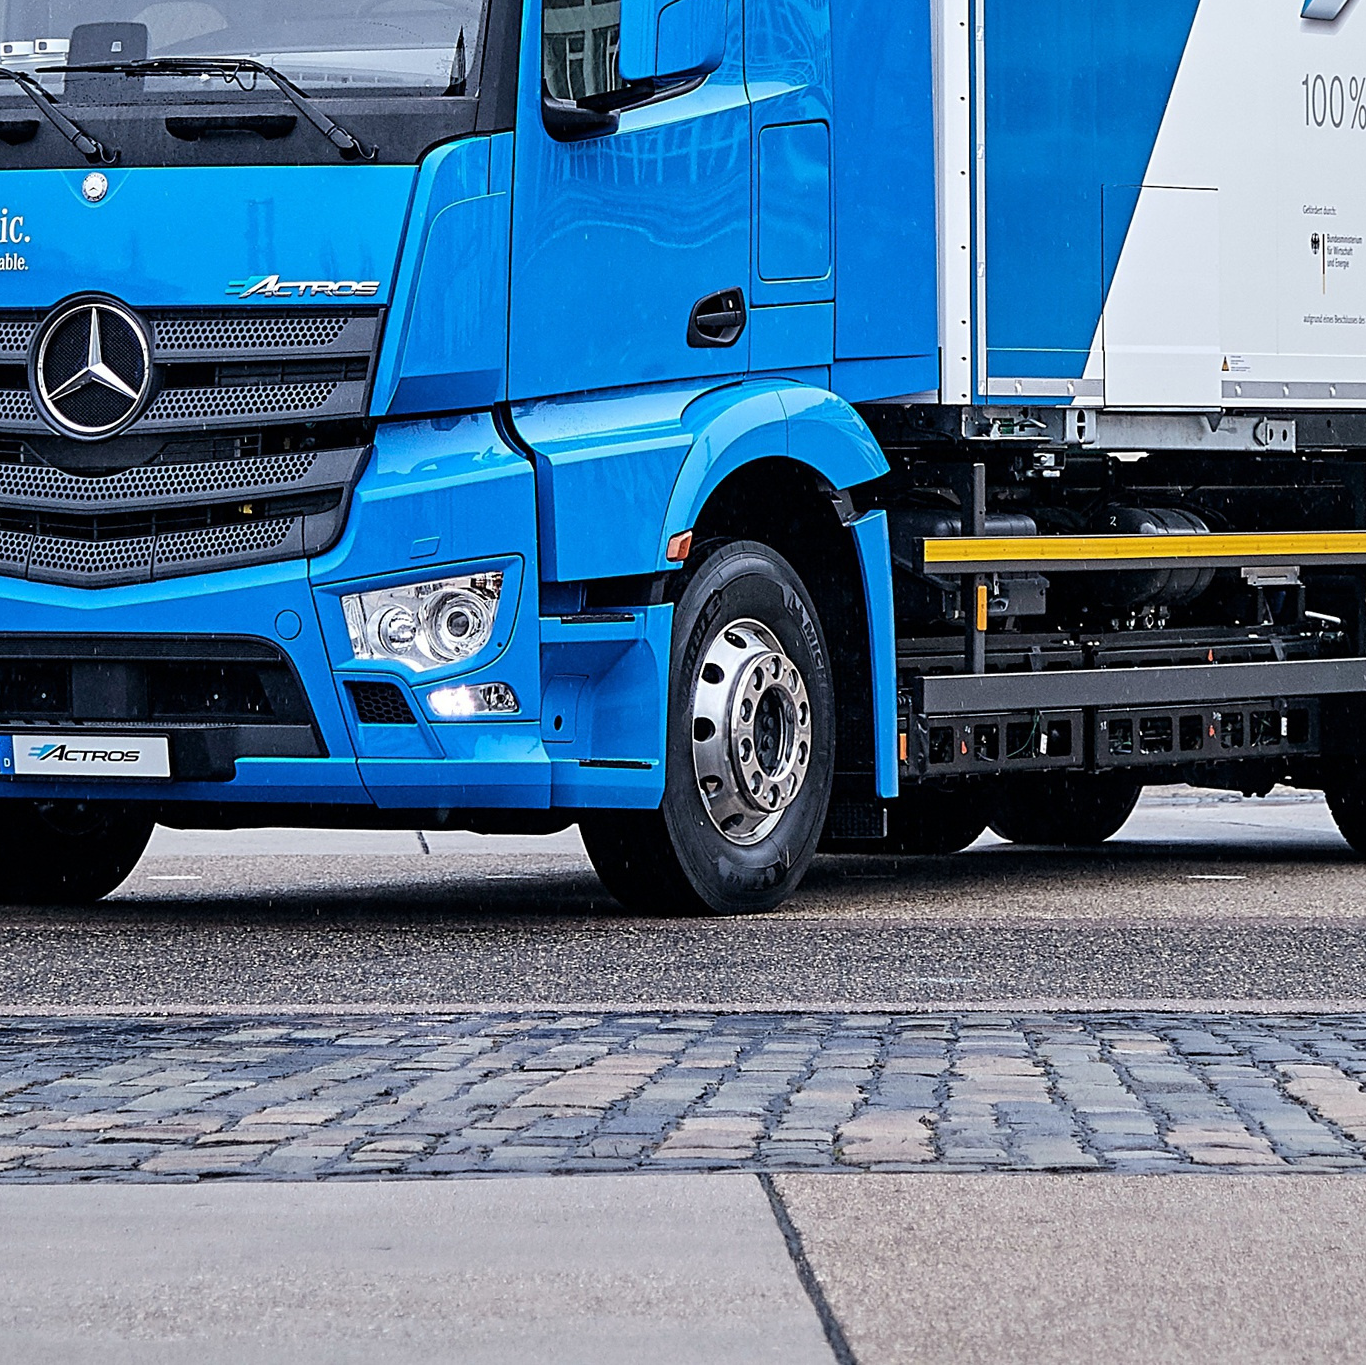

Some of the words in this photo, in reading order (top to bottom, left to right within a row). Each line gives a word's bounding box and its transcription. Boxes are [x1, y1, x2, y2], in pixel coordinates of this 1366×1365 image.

[238, 274, 380, 299] ACTROS
[3, 757, 11, 768] D
[38, 744, 141, 763] ACTROS
